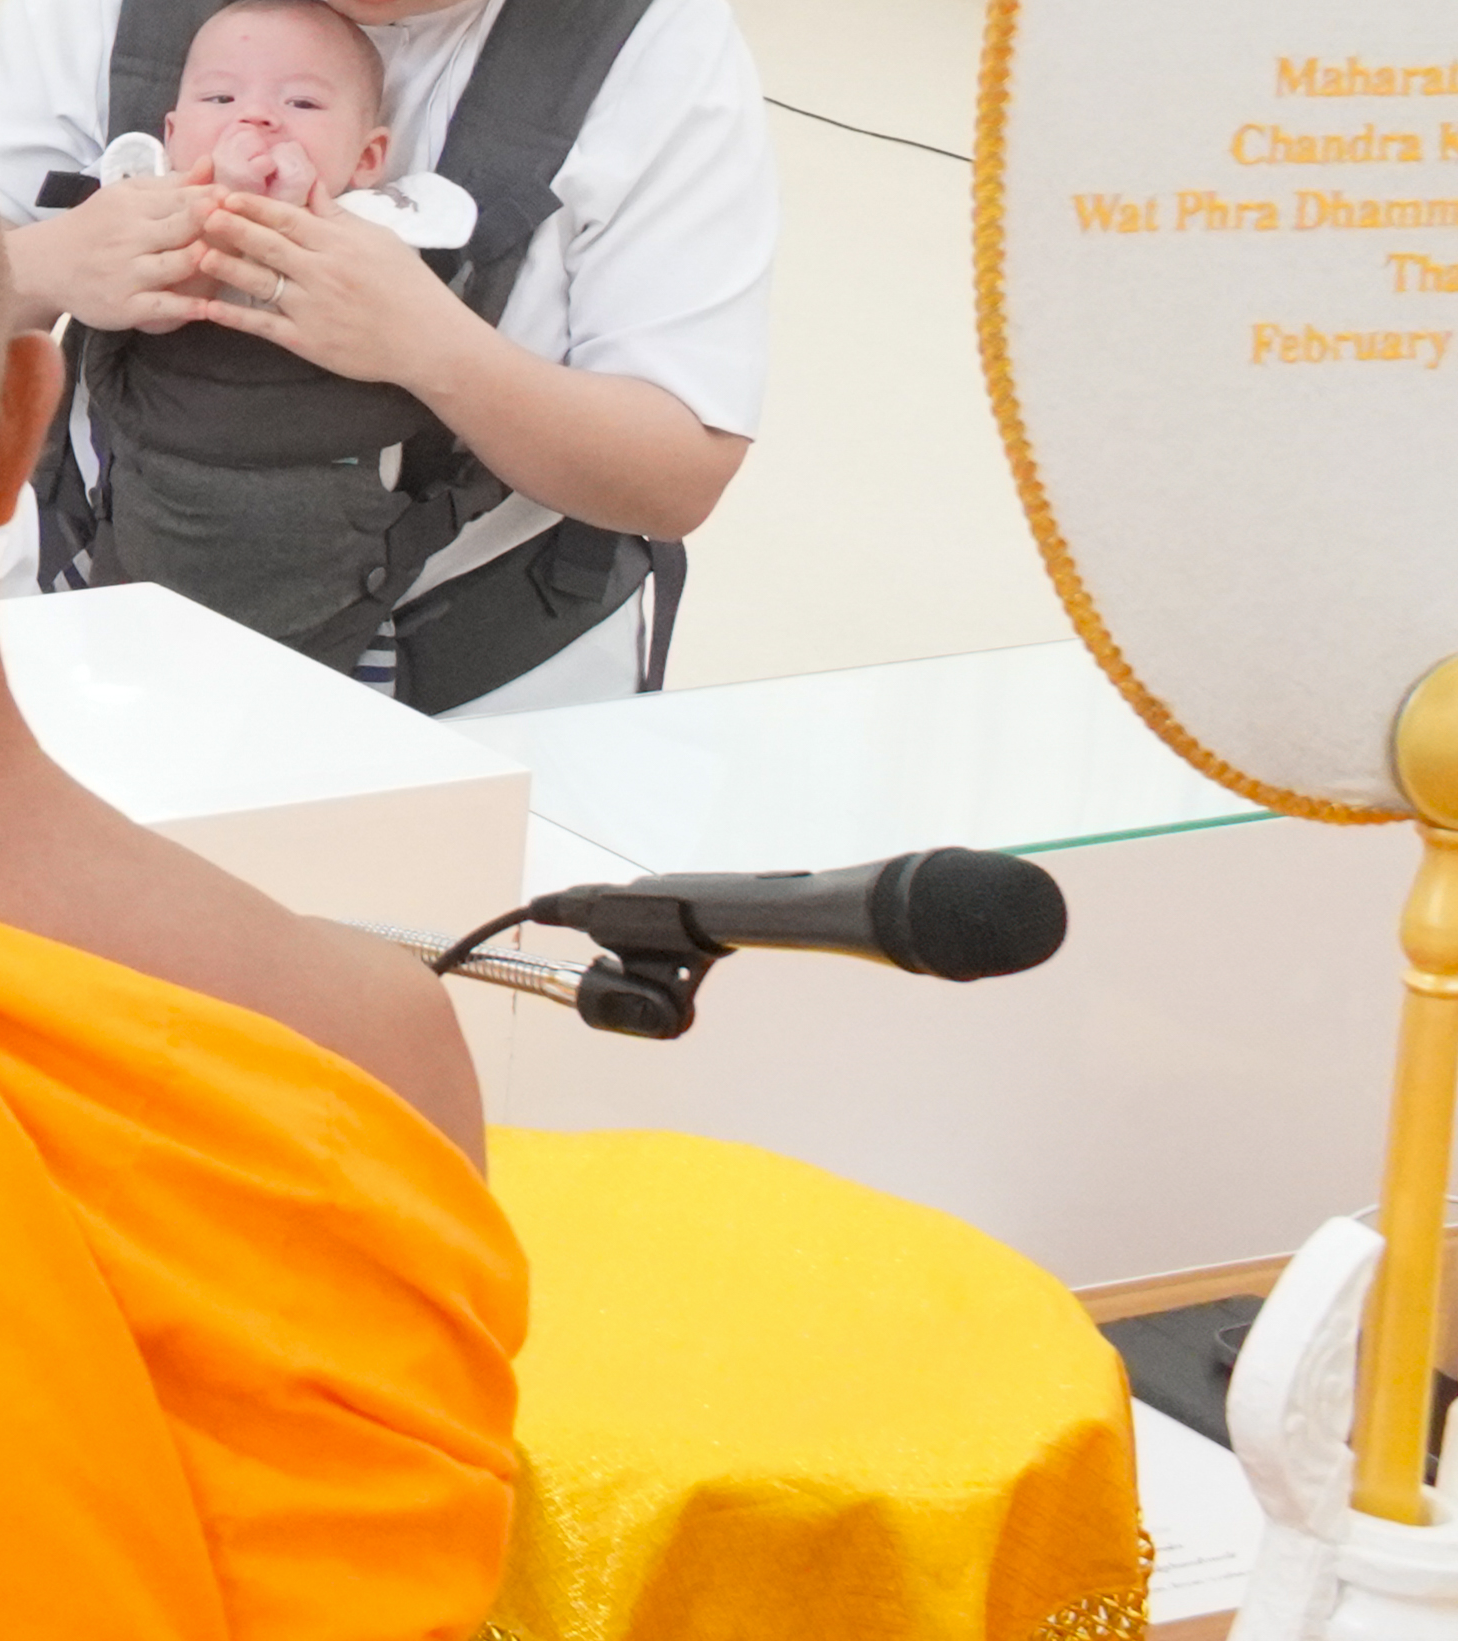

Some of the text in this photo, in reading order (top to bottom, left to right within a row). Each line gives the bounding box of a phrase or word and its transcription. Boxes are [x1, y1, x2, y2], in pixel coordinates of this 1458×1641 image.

[1231, 124, 1422, 165] Chandra
[1073, 193, 1159, 233] Wat
[1177, 191, 1279, 231] Phra
[1252, 324, 1453, 369] February
